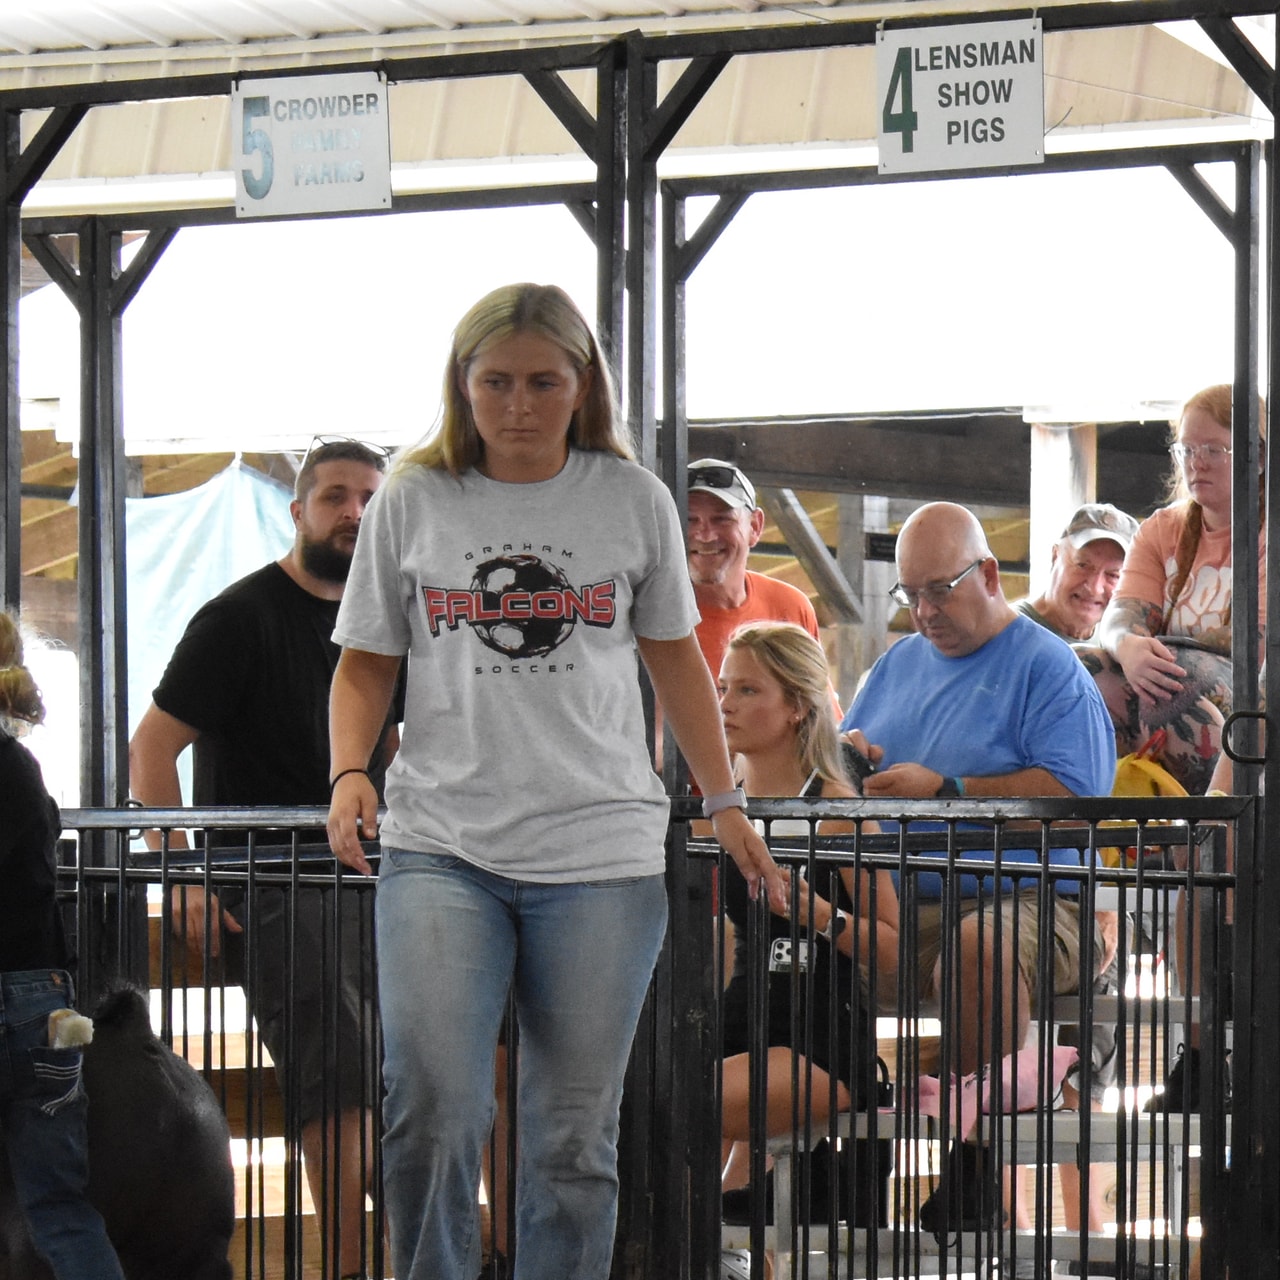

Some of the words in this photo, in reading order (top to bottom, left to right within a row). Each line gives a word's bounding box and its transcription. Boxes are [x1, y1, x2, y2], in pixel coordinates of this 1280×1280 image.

[915, 37, 1035, 72] LENSMAN
[273, 92, 380, 123] CROWDER
[882, 46, 918, 154] 4
[937, 78, 1013, 109] SHOW
[946, 116, 1006, 145] PIGS
[242, 96, 274, 200] 5
[464, 543, 575, 561] GRAHAM
[422, 579, 616, 638] FALCONS
[474, 663, 576, 675] SOCCER
